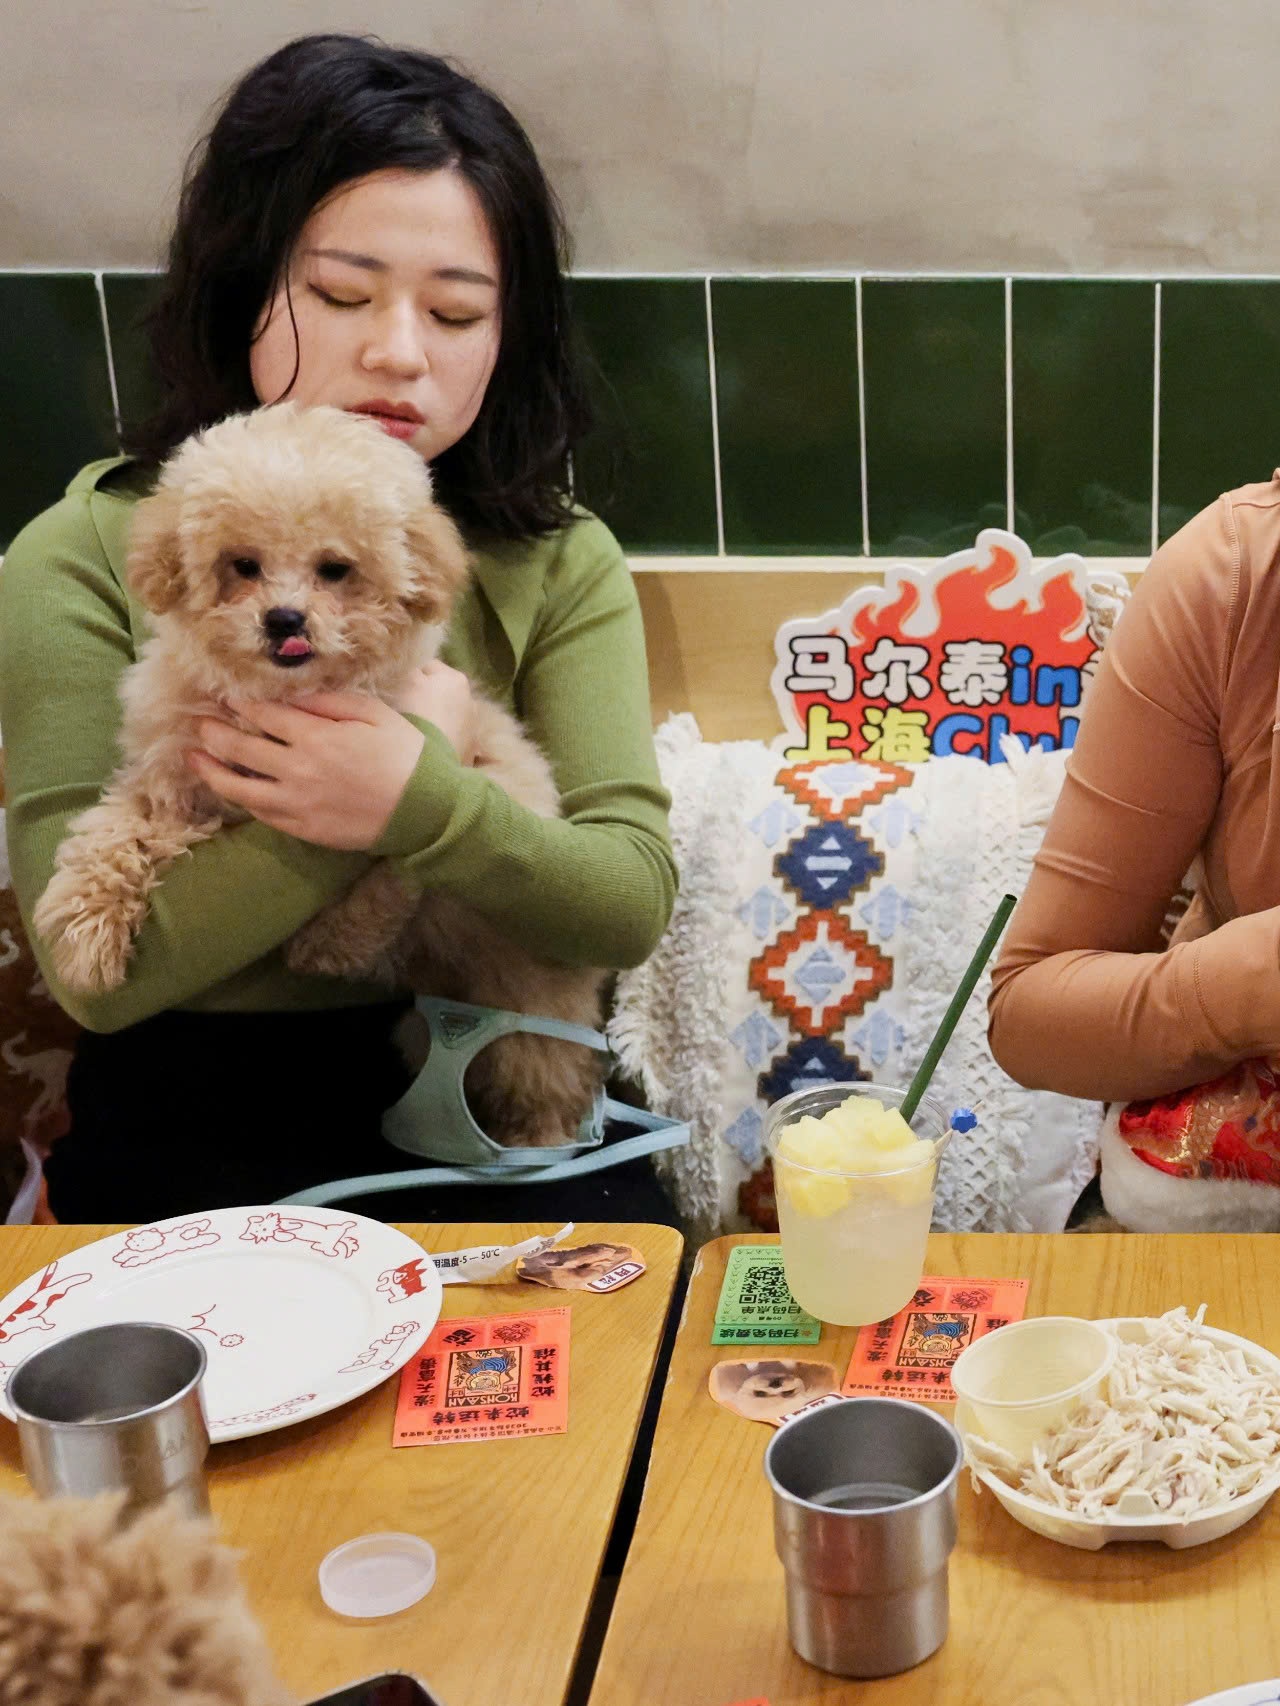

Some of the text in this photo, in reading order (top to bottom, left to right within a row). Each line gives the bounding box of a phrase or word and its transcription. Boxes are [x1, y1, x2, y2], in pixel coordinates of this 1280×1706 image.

[899, 1357, 956, 1368] ONSAAN
[882, 1369, 950, 1385] 来运转
